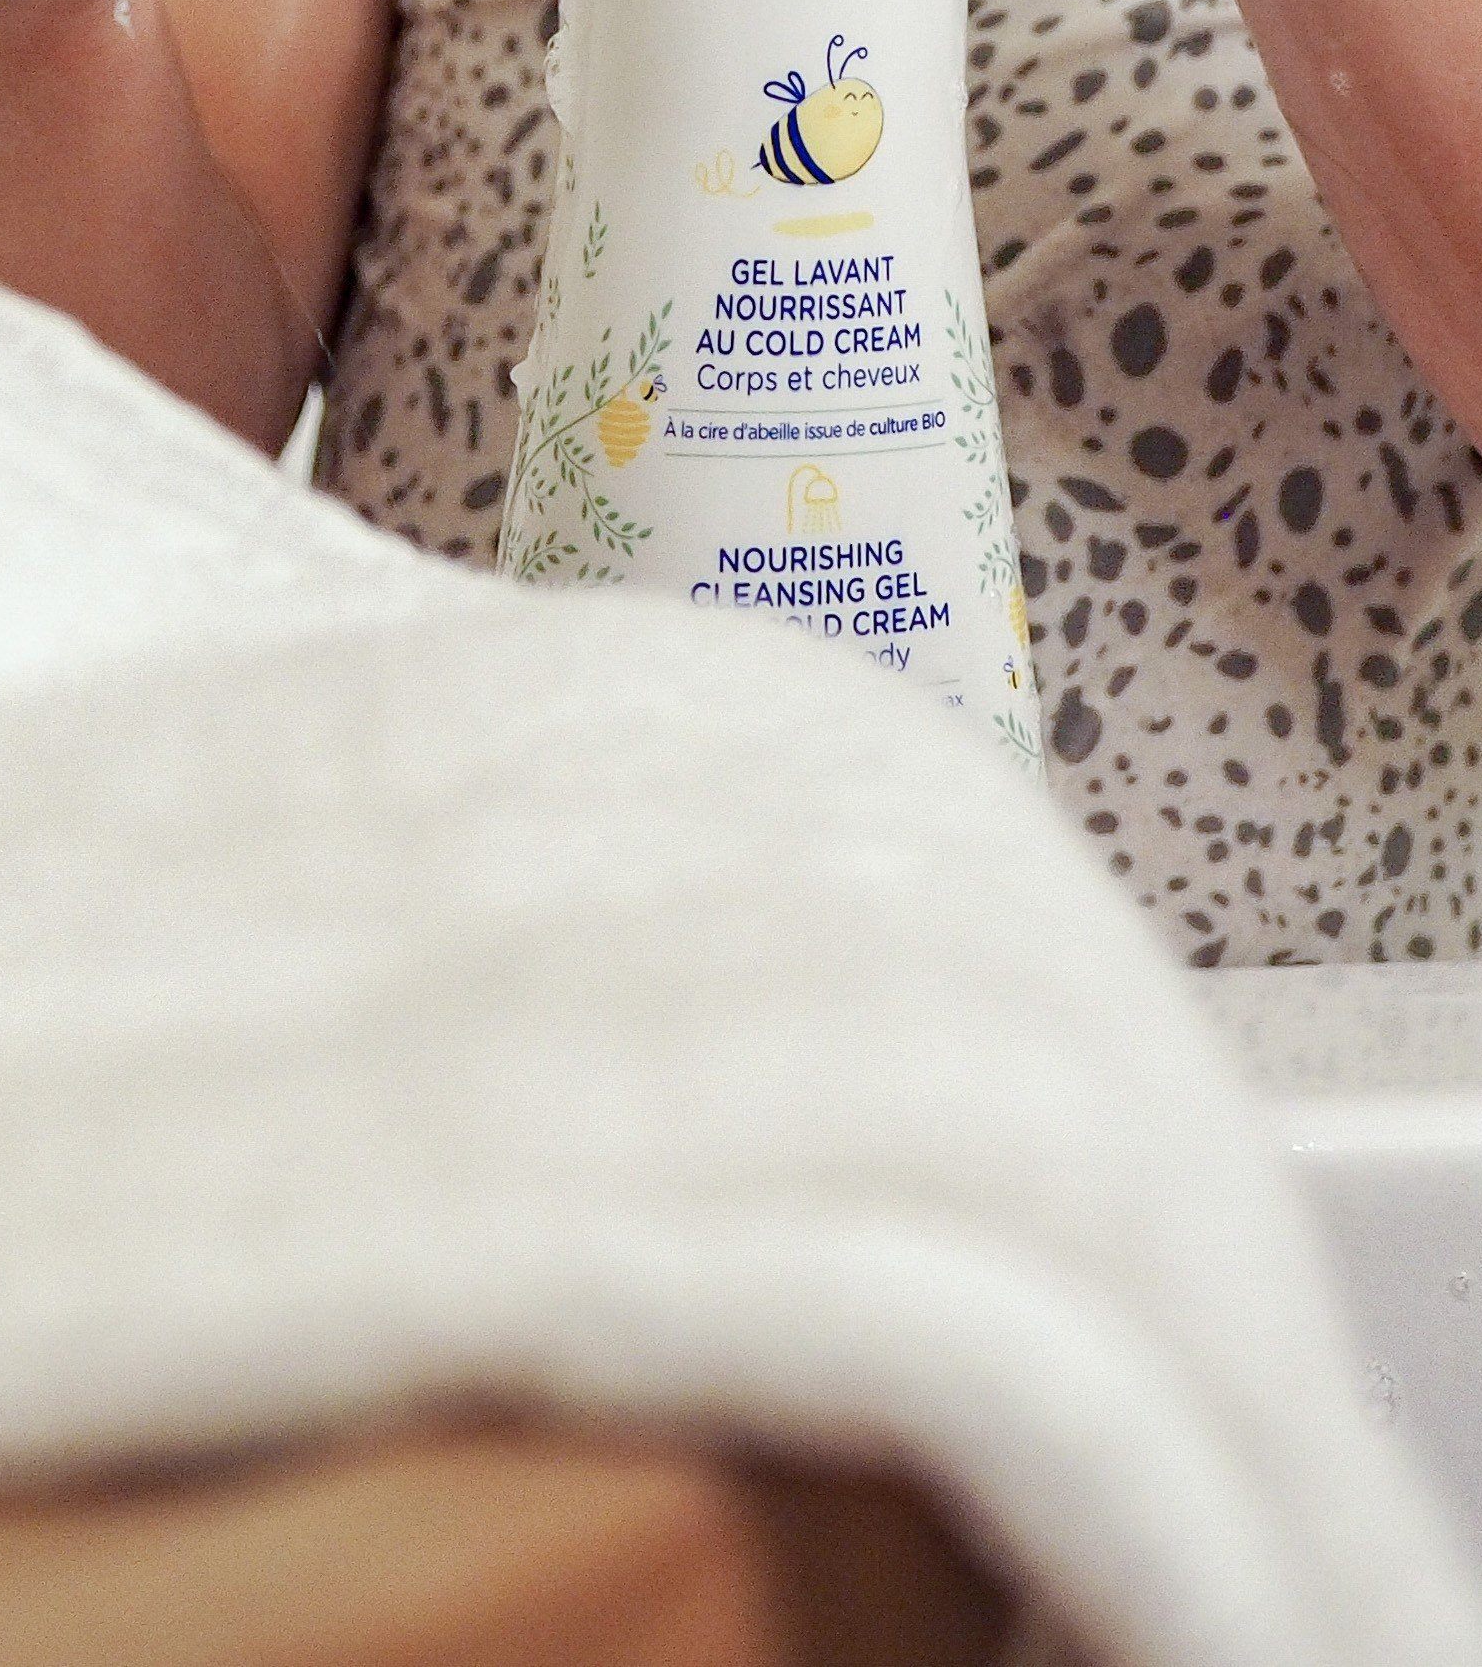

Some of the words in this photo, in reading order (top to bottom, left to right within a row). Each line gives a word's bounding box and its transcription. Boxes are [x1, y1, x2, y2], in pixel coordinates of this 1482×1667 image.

[731, 259, 784, 286] GEL
[794, 256, 894, 286] LAVANT
[716, 289, 907, 321] NOURRISSANT
[696, 328, 735, 355] AU
[745, 330, 824, 356] COLD
[834, 323, 921, 354] CREAM
[697, 363, 778, 396] Corps
[787, 366, 813, 391] et
[822, 363, 921, 389] cheveux
[663, 416, 677, 438] À
[681, 422, 694, 438] la
[698, 422, 728, 439] cire
[733, 422, 800, 440] d'abeille
[804, 422, 842, 439] issue
[846, 419, 866, 436] de
[869, 417, 918, 435] culture
[922, 411, 946, 431] BIO
[719, 539, 904, 573] NOURISHING
[875, 572, 928, 600] GEL
[852, 602, 951, 636] CREAM
